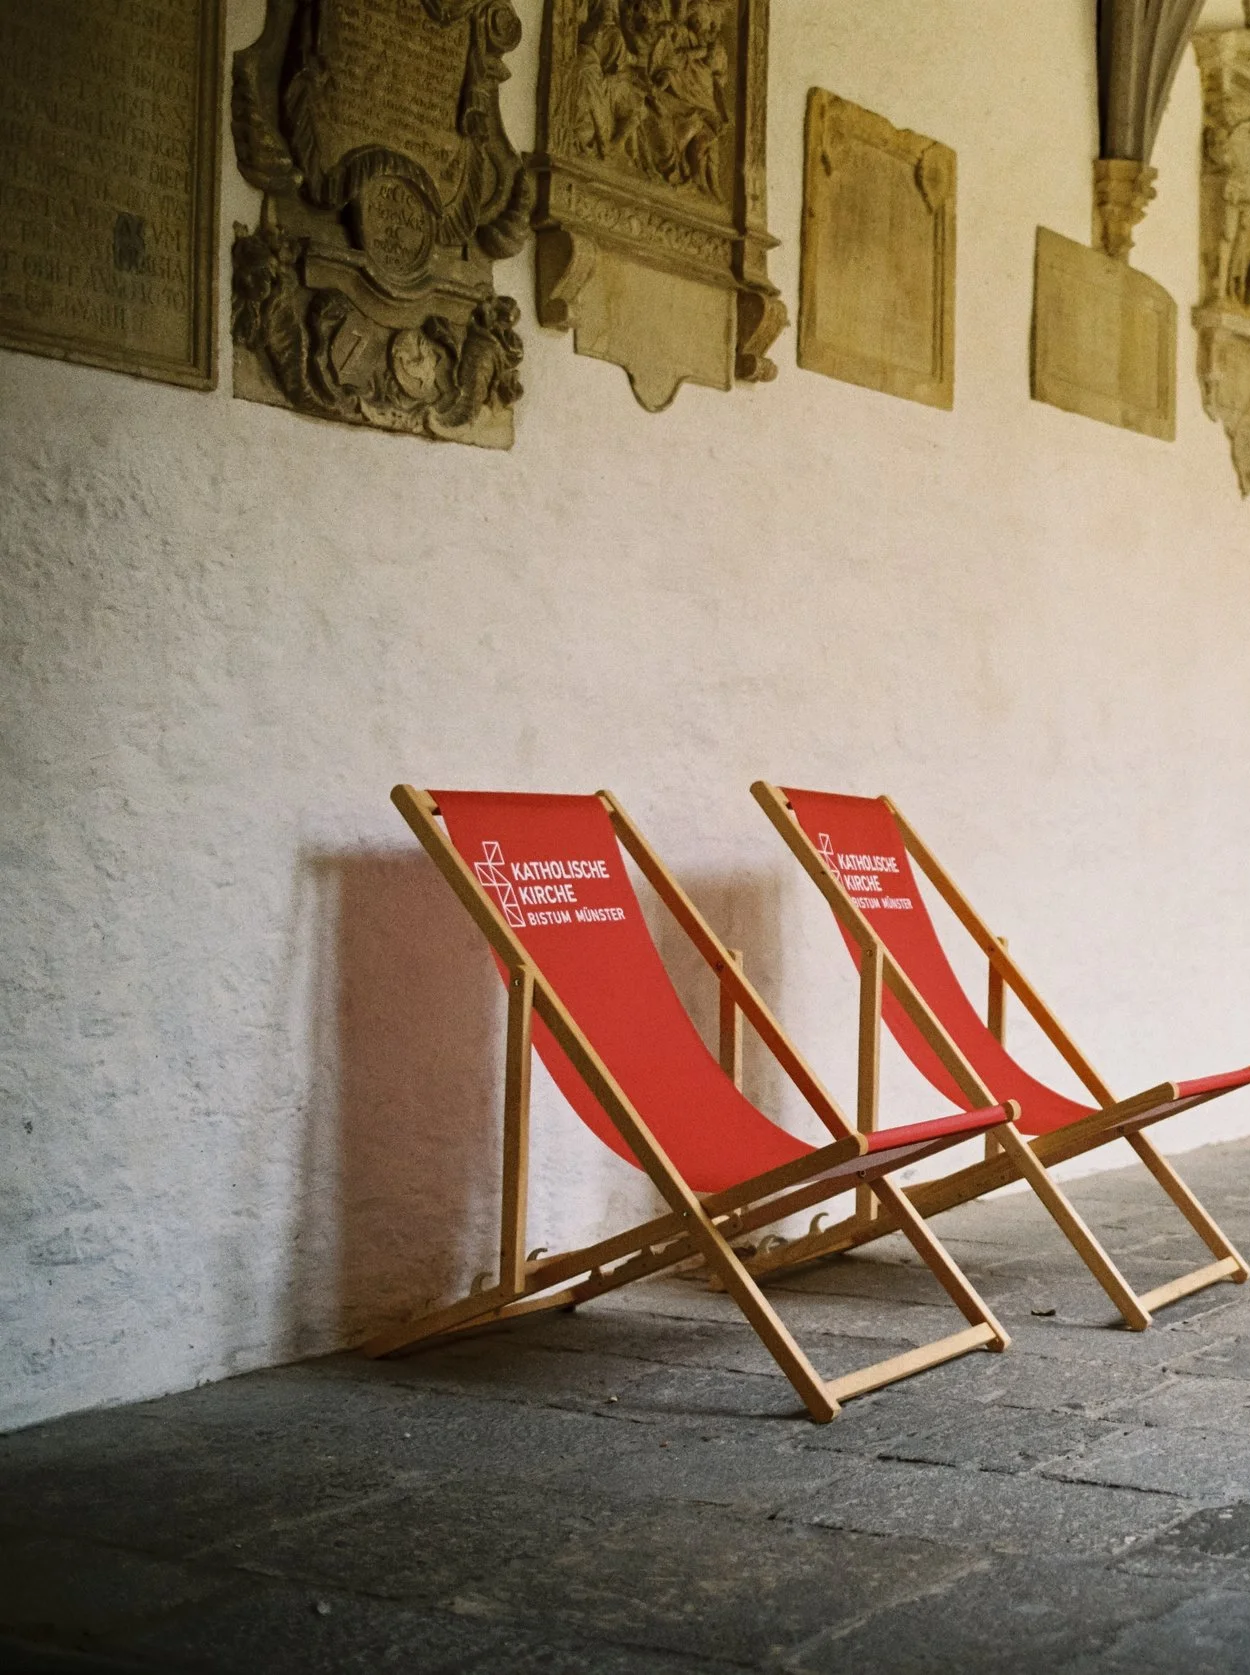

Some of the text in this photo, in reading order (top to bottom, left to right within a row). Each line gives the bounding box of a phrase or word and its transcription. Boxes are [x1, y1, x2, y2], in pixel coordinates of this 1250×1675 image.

[511, 860, 609, 881] KATHOLISCHE
[837, 854, 899, 873] KATHOLISCHE
[844, 875, 882, 892] KIRCHE
[519, 884, 577, 905] KIRCHE
[881, 896, 913, 910] MÜNSTER
[527, 907, 626, 926] BISTUM MÜNSTER
